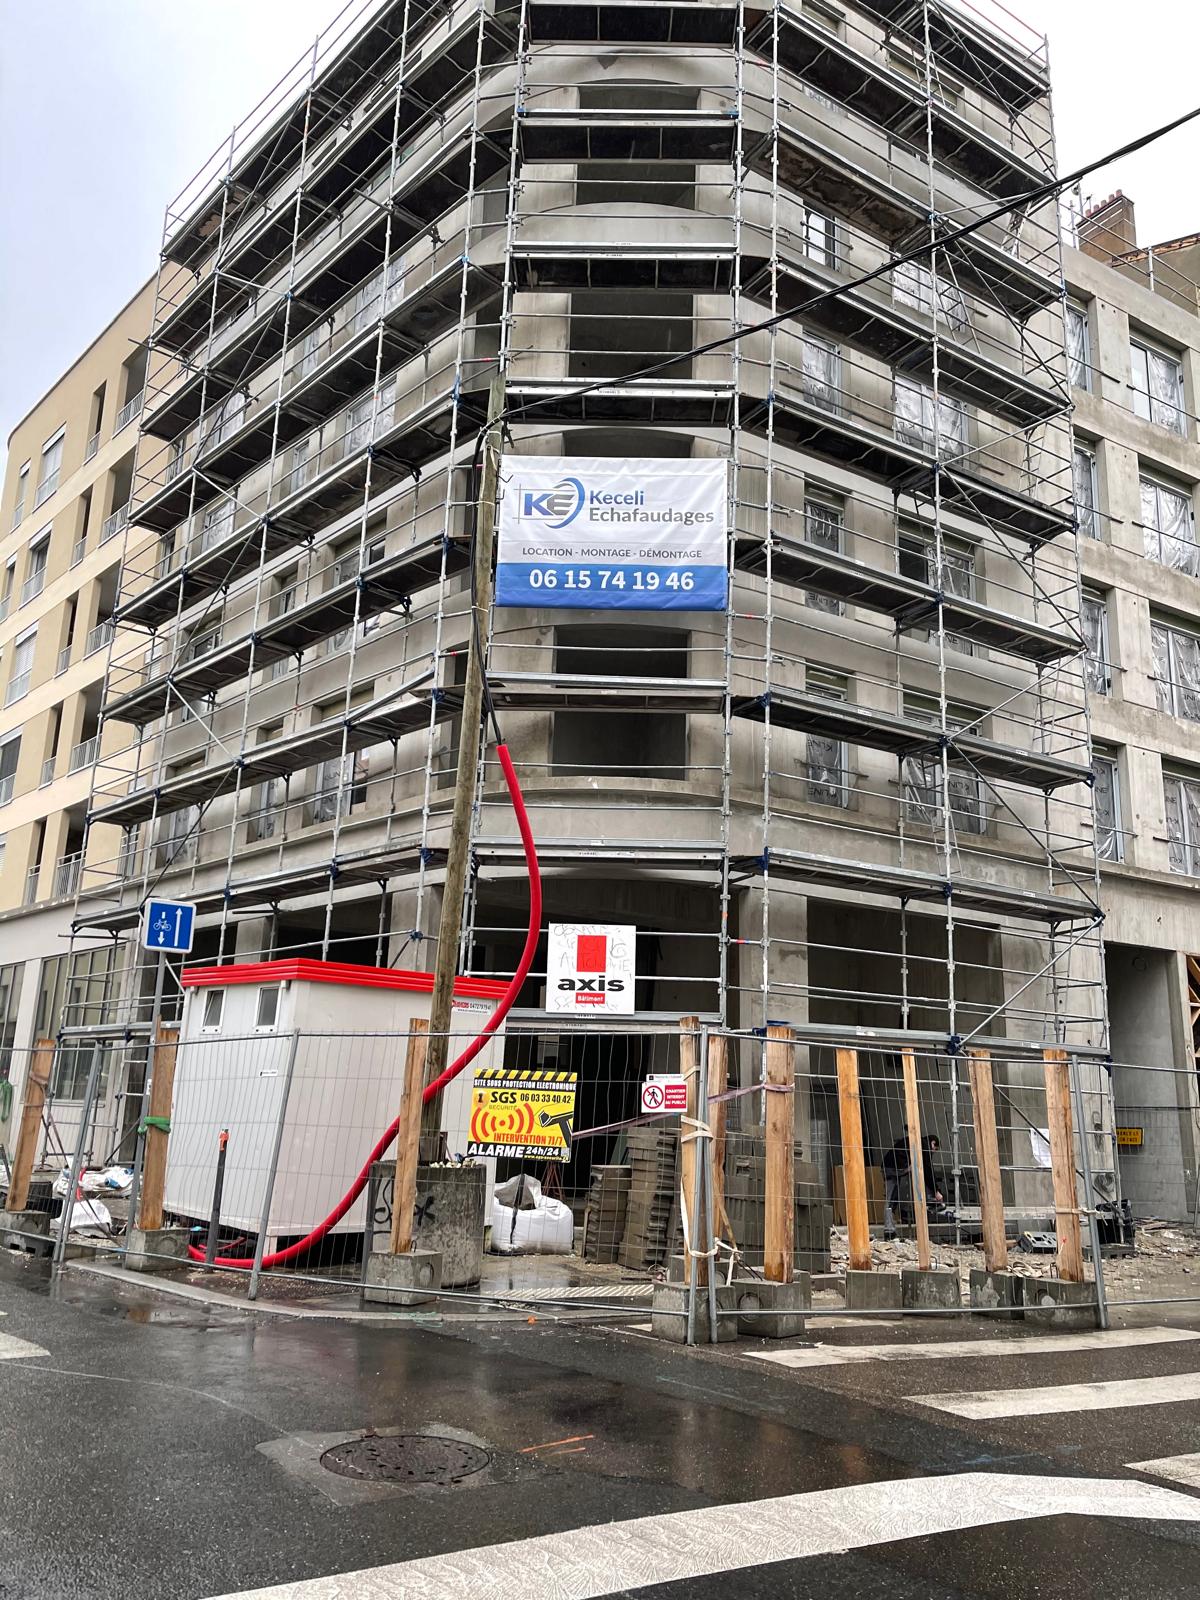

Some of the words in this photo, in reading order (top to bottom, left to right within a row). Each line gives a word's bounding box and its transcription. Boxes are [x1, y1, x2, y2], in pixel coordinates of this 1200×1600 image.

[589, 490, 644, 505] Keceli
[589, 507, 714, 525] Echafaudages
[522, 547, 573, 556] LOCATION
[581, 548, 631, 558] MONTAGE
[639, 548, 702, 558] DÉMONTAGE
[529, 569, 557, 588] 06
[564, 570, 591, 588] 15
[598, 570, 626, 589] 74
[632, 571, 660, 590] 19
[665, 572, 695, 590] 46
[558, 975, 625, 992] axis
[474, 1079, 486, 1087] SITE
[487, 1080, 501, 1088] SOUS
[502, 1080, 535, 1089] PROTECTION
[536, 1082, 576, 1091] ELECTRONIQUE
[490, 1091, 517, 1104] SGS
[520, 1093, 530, 1102] 06
[530, 1094, 540, 1102] 03
[542, 1094, 550, 1102] 33
[552, 1094, 561, 1103] 40
[562, 1095, 571, 1104] 42
[494, 1132, 546, 1144] INTERVENTION
[468, 1143, 525, 1158] ALARME
[526, 1147, 559, 1156] 24h/24
